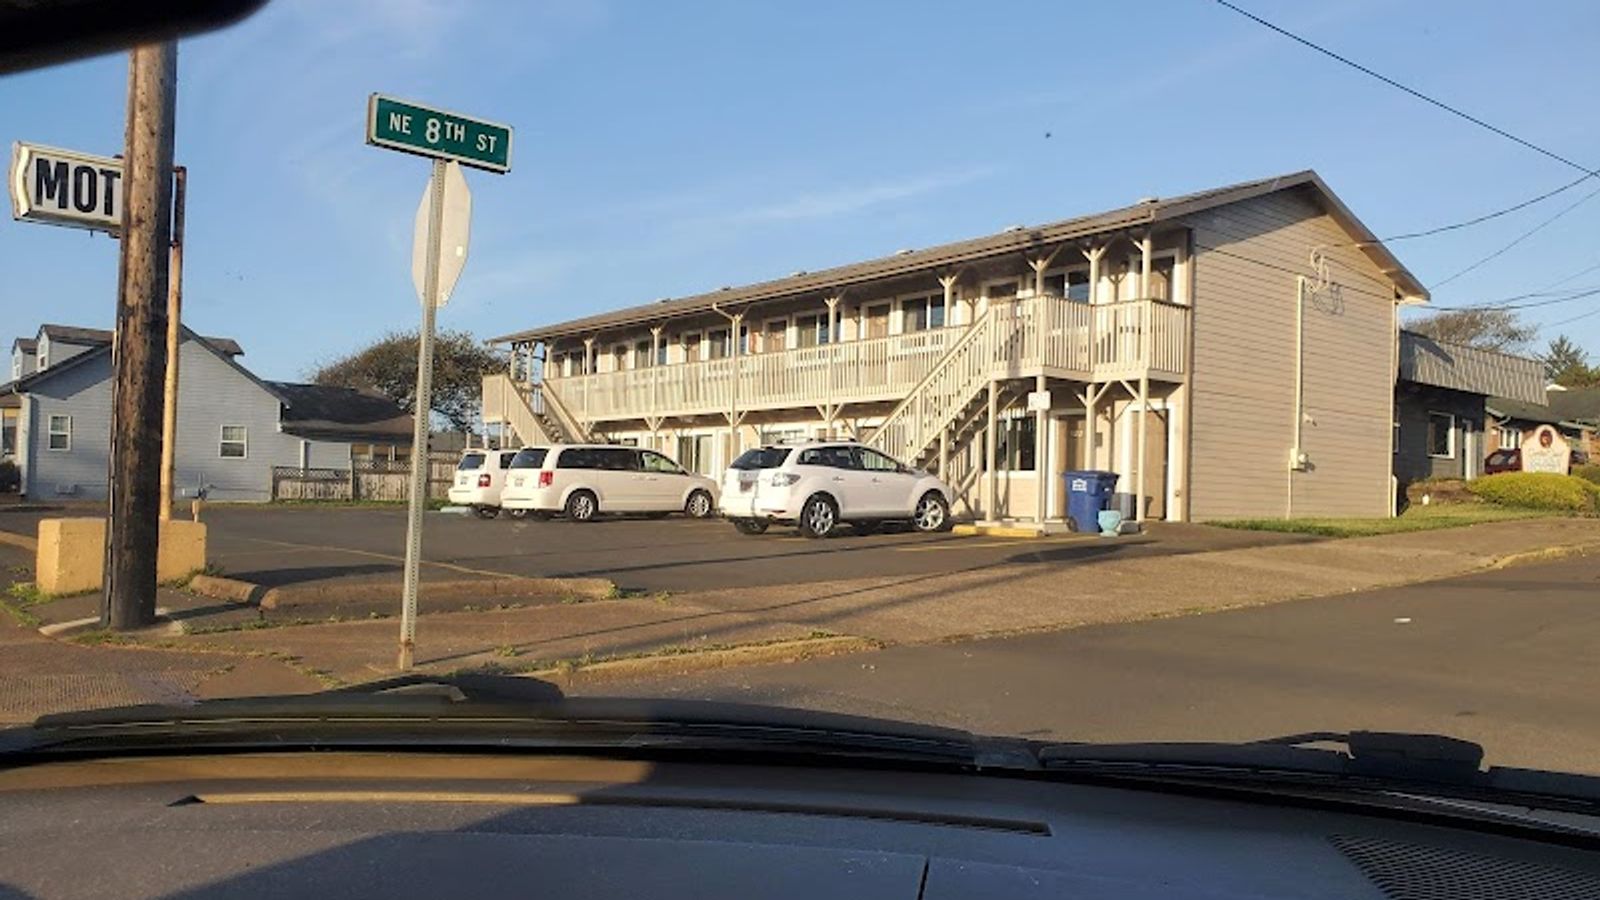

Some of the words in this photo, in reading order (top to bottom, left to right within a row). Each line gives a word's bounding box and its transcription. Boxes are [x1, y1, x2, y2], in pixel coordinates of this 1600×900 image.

[389, 112, 412, 135] NE
[425, 118, 466, 144] 8TH
[475, 133, 498, 154] ST
[35, 158, 122, 216] MOT
